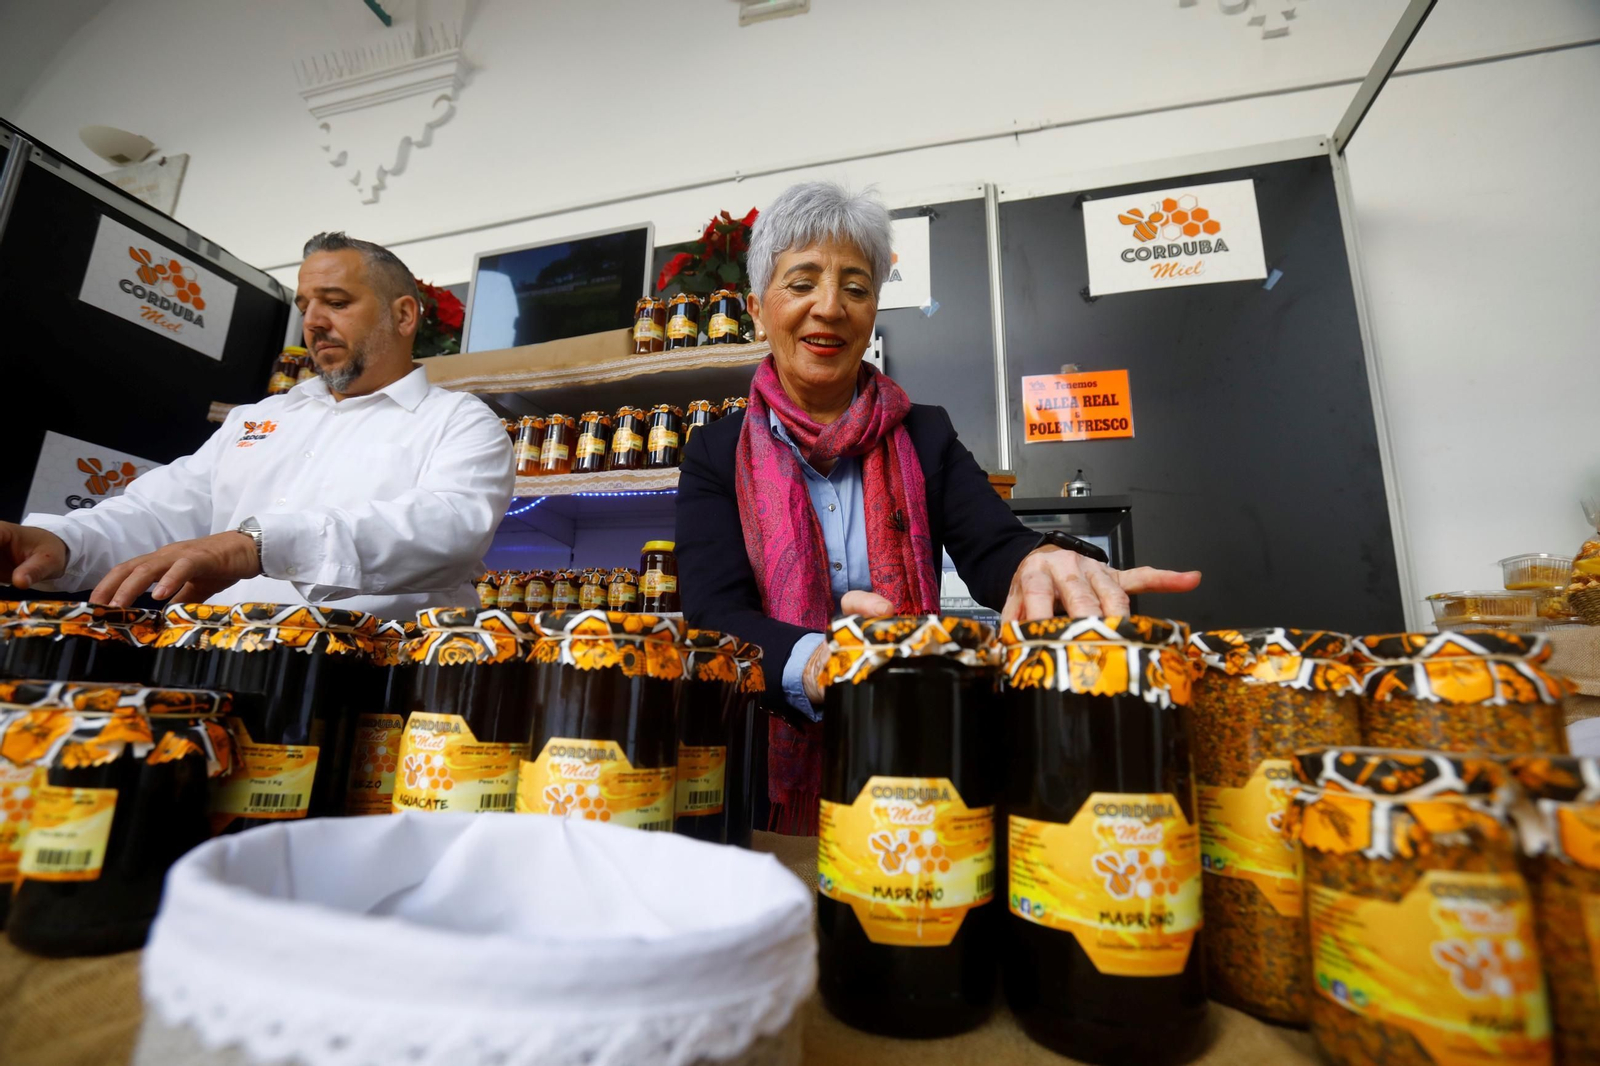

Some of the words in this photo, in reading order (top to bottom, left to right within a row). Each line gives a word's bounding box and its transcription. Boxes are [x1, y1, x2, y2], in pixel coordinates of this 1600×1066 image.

[1120, 237, 1230, 263] CORDUBA
[1150, 260, 1204, 279] Miel
[118, 278, 205, 329] CORDUBA
[140, 304, 184, 333] Miel
[1054, 380, 1098, 390] Tenemos
[1036, 396, 1079, 411] JALEA
[1082, 393, 1119, 408] REAL
[1029, 420, 1074, 436] POLEN
[1077, 417, 1129, 433] FRESCO
[409, 718, 462, 734] CORDUBA
[416, 734, 445, 749] Miel
[548, 745, 618, 761] CORDUBA
[562, 761, 599, 777] Miel
[871, 785, 952, 802] CORDUBA
[399, 794, 449, 810] AGUACATE
[891, 806, 934, 822] Miel
[1093, 803, 1177, 819] CORDUBA
[1117, 824, 1164, 842] Miel
